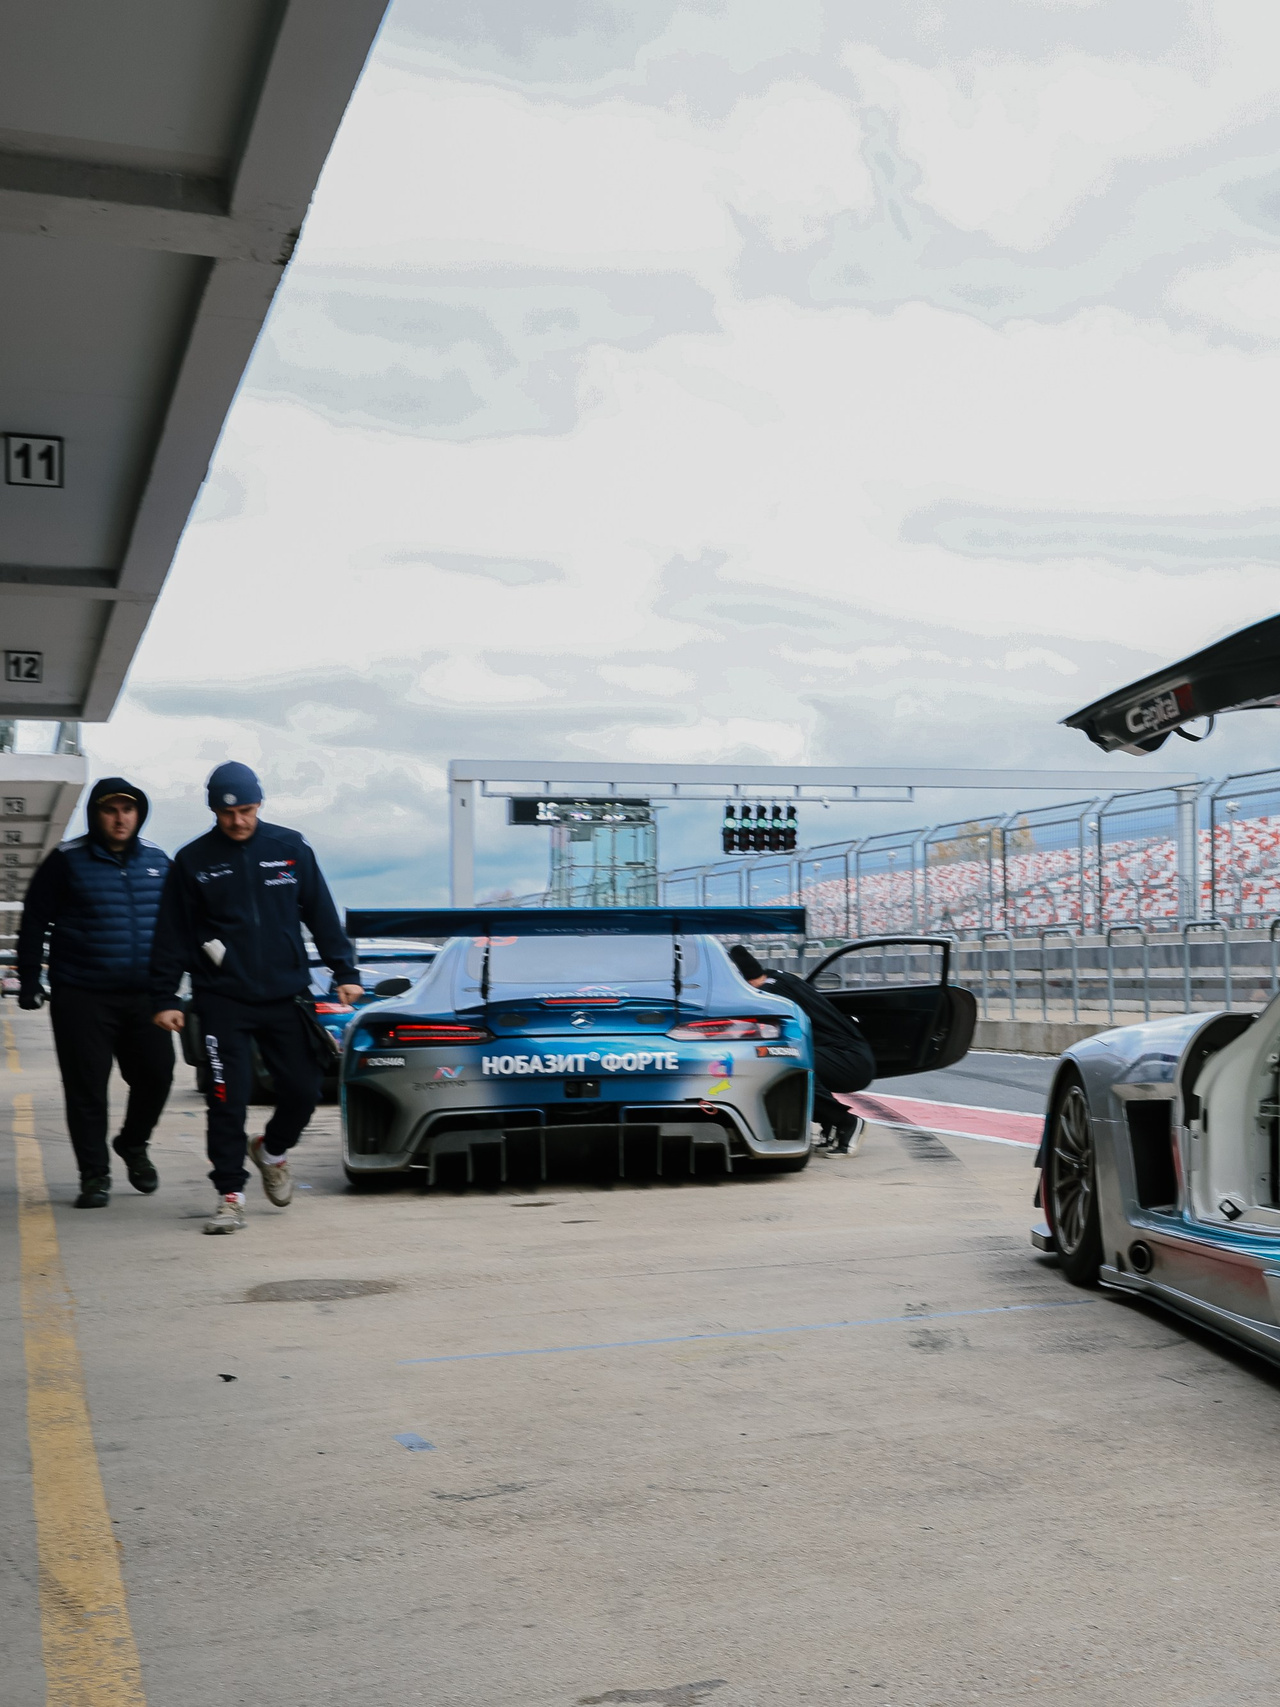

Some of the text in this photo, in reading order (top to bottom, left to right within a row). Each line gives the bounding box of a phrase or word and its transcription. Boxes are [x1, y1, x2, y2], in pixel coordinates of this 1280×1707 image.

[14, 442, 55, 481] 11
[9, 656, 40, 679] 12
[600, 1052, 679, 1072] ФОРТЕ
